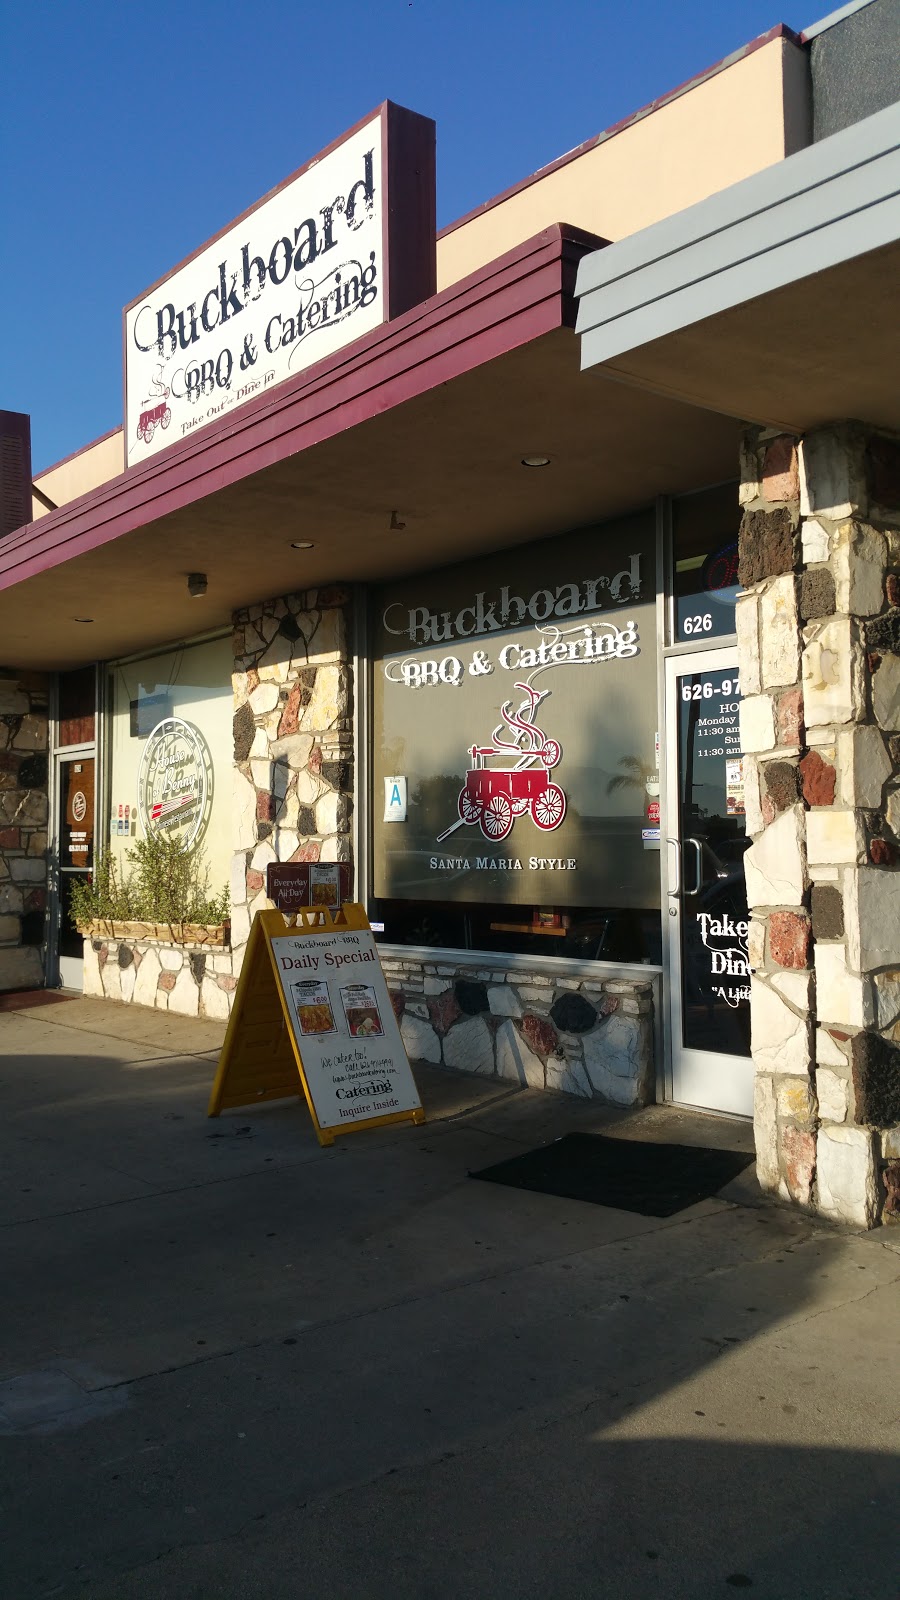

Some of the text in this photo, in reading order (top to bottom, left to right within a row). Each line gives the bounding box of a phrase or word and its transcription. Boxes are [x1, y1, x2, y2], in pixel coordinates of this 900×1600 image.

[133, 147, 376, 361] Buckboard
[171, 251, 378, 404] BBQ & Catering
[181, 416, 204, 435] Take
[206, 397, 227, 418] Out
[235, 381, 260, 401] Dine
[263, 370, 275, 388] In
[383, 553, 643, 646] Buckboard
[683, 613, 713, 635] 626
[384, 620, 640, 689] BBQ & Catering
[697, 716, 737, 727] Monday
[697, 727, 724, 737] 11:30
[149, 742, 186, 772] House
[697, 748, 724, 757] 11:30
[161, 766, 196, 794] Benny
[390, 784, 402, 806] A
[429, 857, 577, 871] SANTA MARIA STYLE
[273, 878, 308, 889] Everyday
[278, 888, 304, 899] All Day
[288, 935, 360, 949] Buckboard BBQ
[280, 949, 376, 970] Daily Special
[335, 1080, 393, 1103] Catering
[338, 1098, 400, 1118] Inquire Inside
